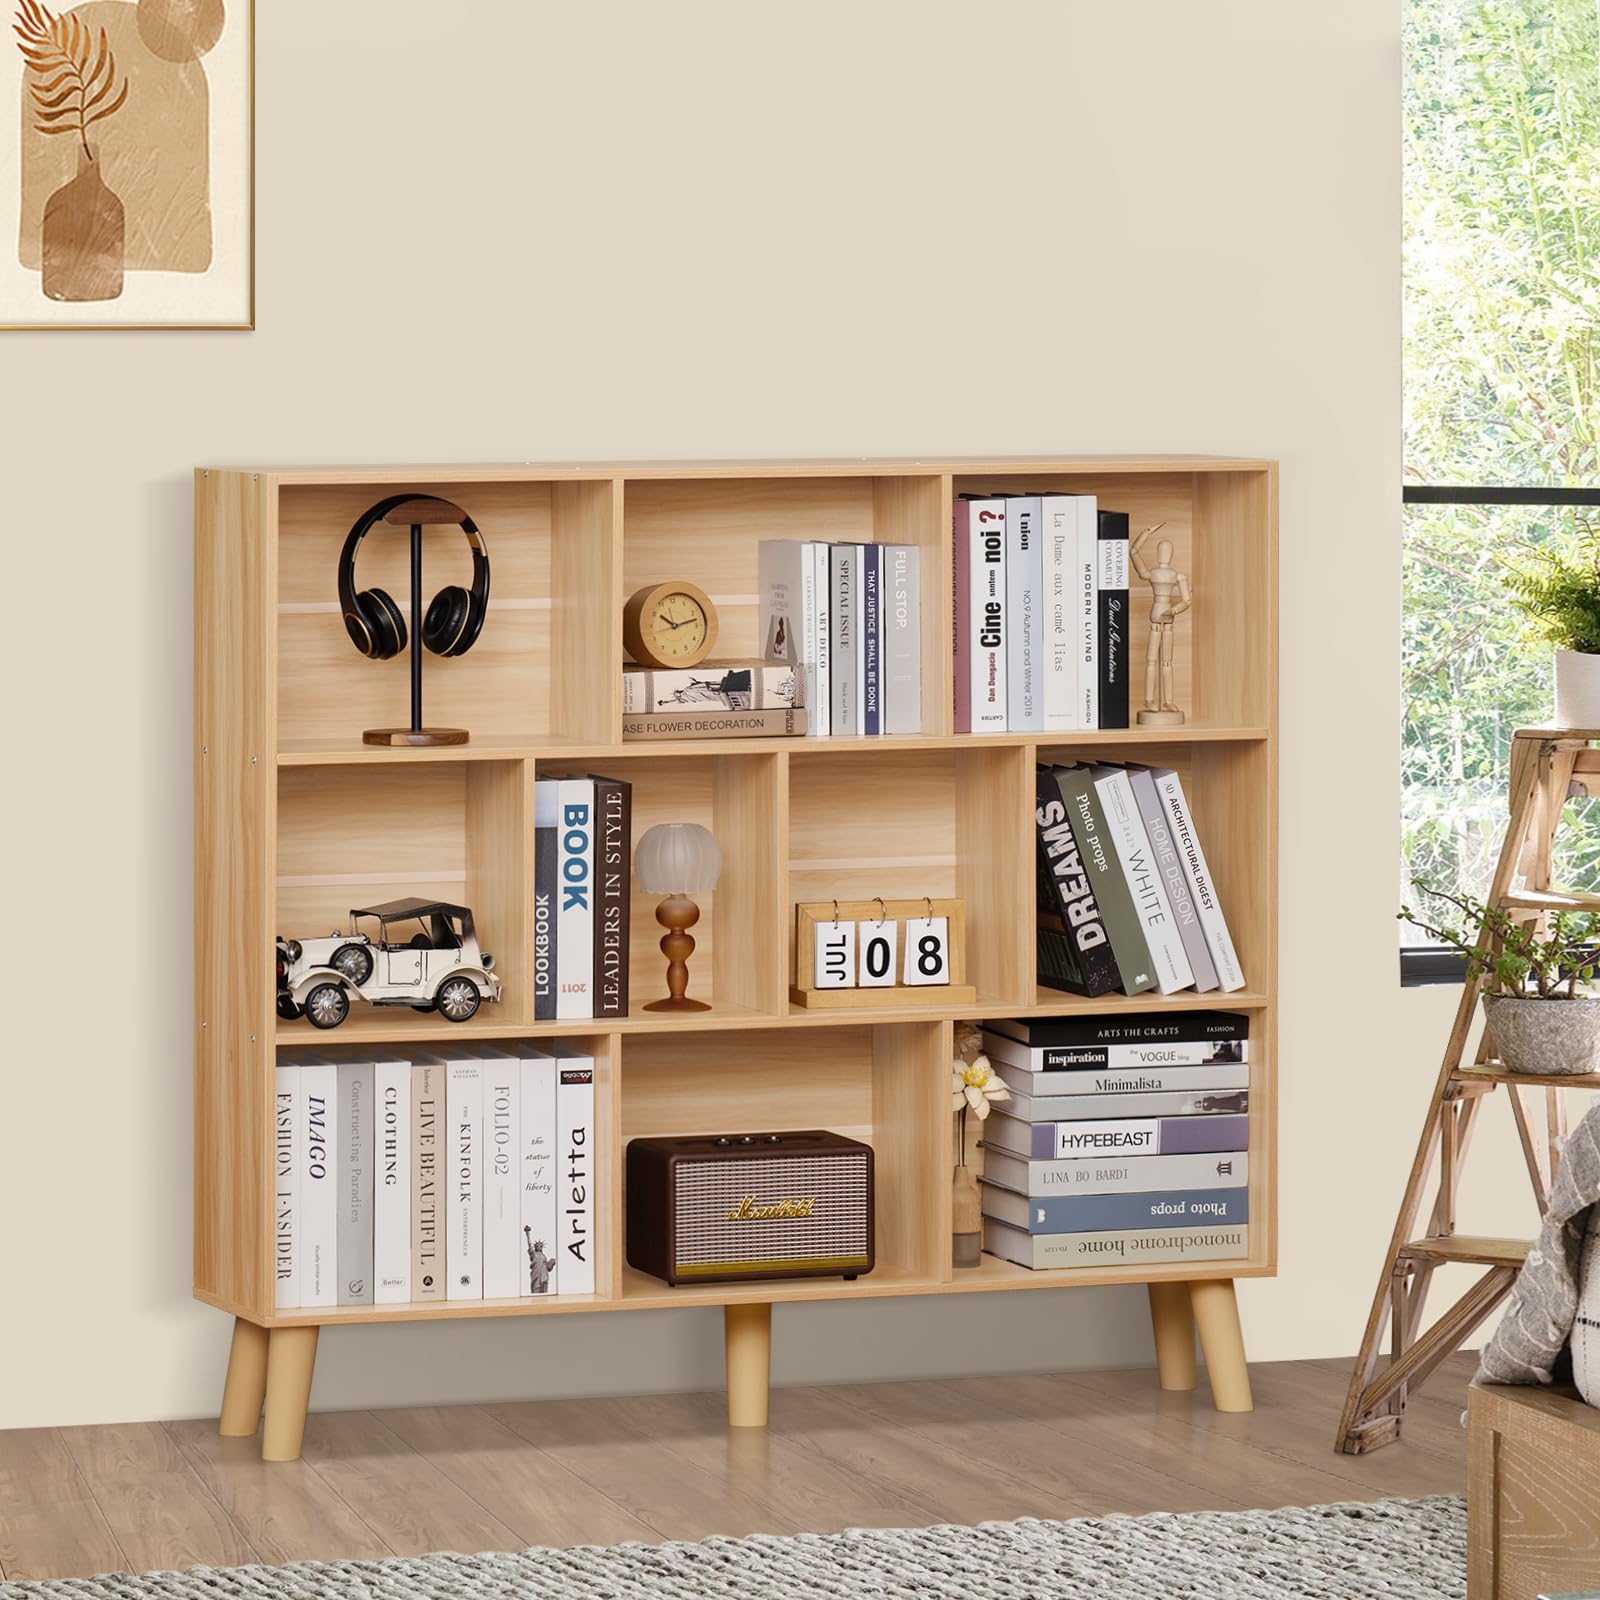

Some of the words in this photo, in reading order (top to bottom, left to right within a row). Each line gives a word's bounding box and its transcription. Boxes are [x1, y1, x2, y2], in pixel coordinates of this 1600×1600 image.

[978, 510, 1004, 524] ?
[1020, 512, 1031, 551] Union
[1054, 513, 1065, 528] La
[980, 530, 1001, 563] noi
[1054, 536, 1065, 566] Dame
[896, 551, 907, 587] FULL
[1104, 541, 1112, 587] COMMUTE
[1116, 541, 1124, 588] COVERING
[840, 560, 849, 612] SPECIAL
[1054, 572, 1062, 596] aux
[818, 610, 827, 632] ART
[896, 590, 908, 632] STOP.
[980, 602, 1001, 648] Cine
[1054, 603, 1063, 632] camé
[840, 614, 849, 649] ISSUE
[1024, 614, 1032, 648] Autumn
[818, 638, 828, 669] DECO
[988, 652, 996, 686] Dungaciu
[1024, 649, 1032, 666] and
[1054, 643, 1065, 672] lias
[1108, 627, 1121, 684] Intentions
[868, 674, 876, 684] BE
[988, 688, 996, 702] Dan
[1024, 668, 1032, 694] Winter
[1024, 696, 1032, 717] 2018
[646, 718, 692, 733] FLOWER
[694, 718, 765, 732] DECORATION
[606, 792, 622, 864] STYLE
[1076, 792, 1096, 833] Photo
[1086, 834, 1108, 872] props
[1149, 818, 1176, 866] HOME
[562, 804, 589, 912] BOOK
[1164, 782, 1174, 794] AD
[1169, 798, 1200, 876] ARCHITECTURAL
[1196, 876, 1214, 911] DIGEST
[604, 873, 620, 898] IN
[1036, 800, 1107, 952] DREAMS
[1128, 848, 1166, 927] WHITE
[536, 894, 550, 996] LOOKBOOK
[603, 906, 620, 1011] LEADERS
[826, 934, 846, 981] JUL
[866, 936, 890, 978] 0
[917, 935, 943, 976] 8
[562, 983, 587, 993] 2011
[1098, 1028, 1122, 1038] ARTS
[1124, 1028, 1141, 1036] THE
[1144, 1026, 1180, 1036] CRAFTS
[1206, 1025, 1236, 1033] FASHION
[1048, 1052, 1106, 1064] inspiration
[1140, 1050, 1176, 1062] VOGUE
[1096, 1077, 1162, 1092] Minimalista
[276, 1092, 292, 1177] FASHION
[308, 1095, 326, 1180] IMAGO
[350, 1080, 362, 1163] Constructing
[384, 1087, 397, 1186] CLOTHING
[420, 1100, 435, 1146] LIVE
[494, 1086, 510, 1176] FOLIO-02
[531, 1137, 544, 1146] the
[1062, 1132, 1152, 1148] HYPEBEAST
[460, 1123, 471, 1202] KINFOLK
[532, 1166, 542, 1178] of
[1042, 1172, 1071, 1184] LINA
[1076, 1172, 1090, 1182] BO
[1096, 1168, 1128, 1181] BARDI
[526, 1182, 552, 1194] liberty
[566, 1126, 586, 1262] Arletta
[420, 1153, 436, 1266] BEAUTIFUL
[1150, 1203, 1185, 1216] props
[1190, 1202, 1227, 1215] Photo
[1078, 1238, 1125, 1256] home
[1130, 1233, 1242, 1250] monochrome
